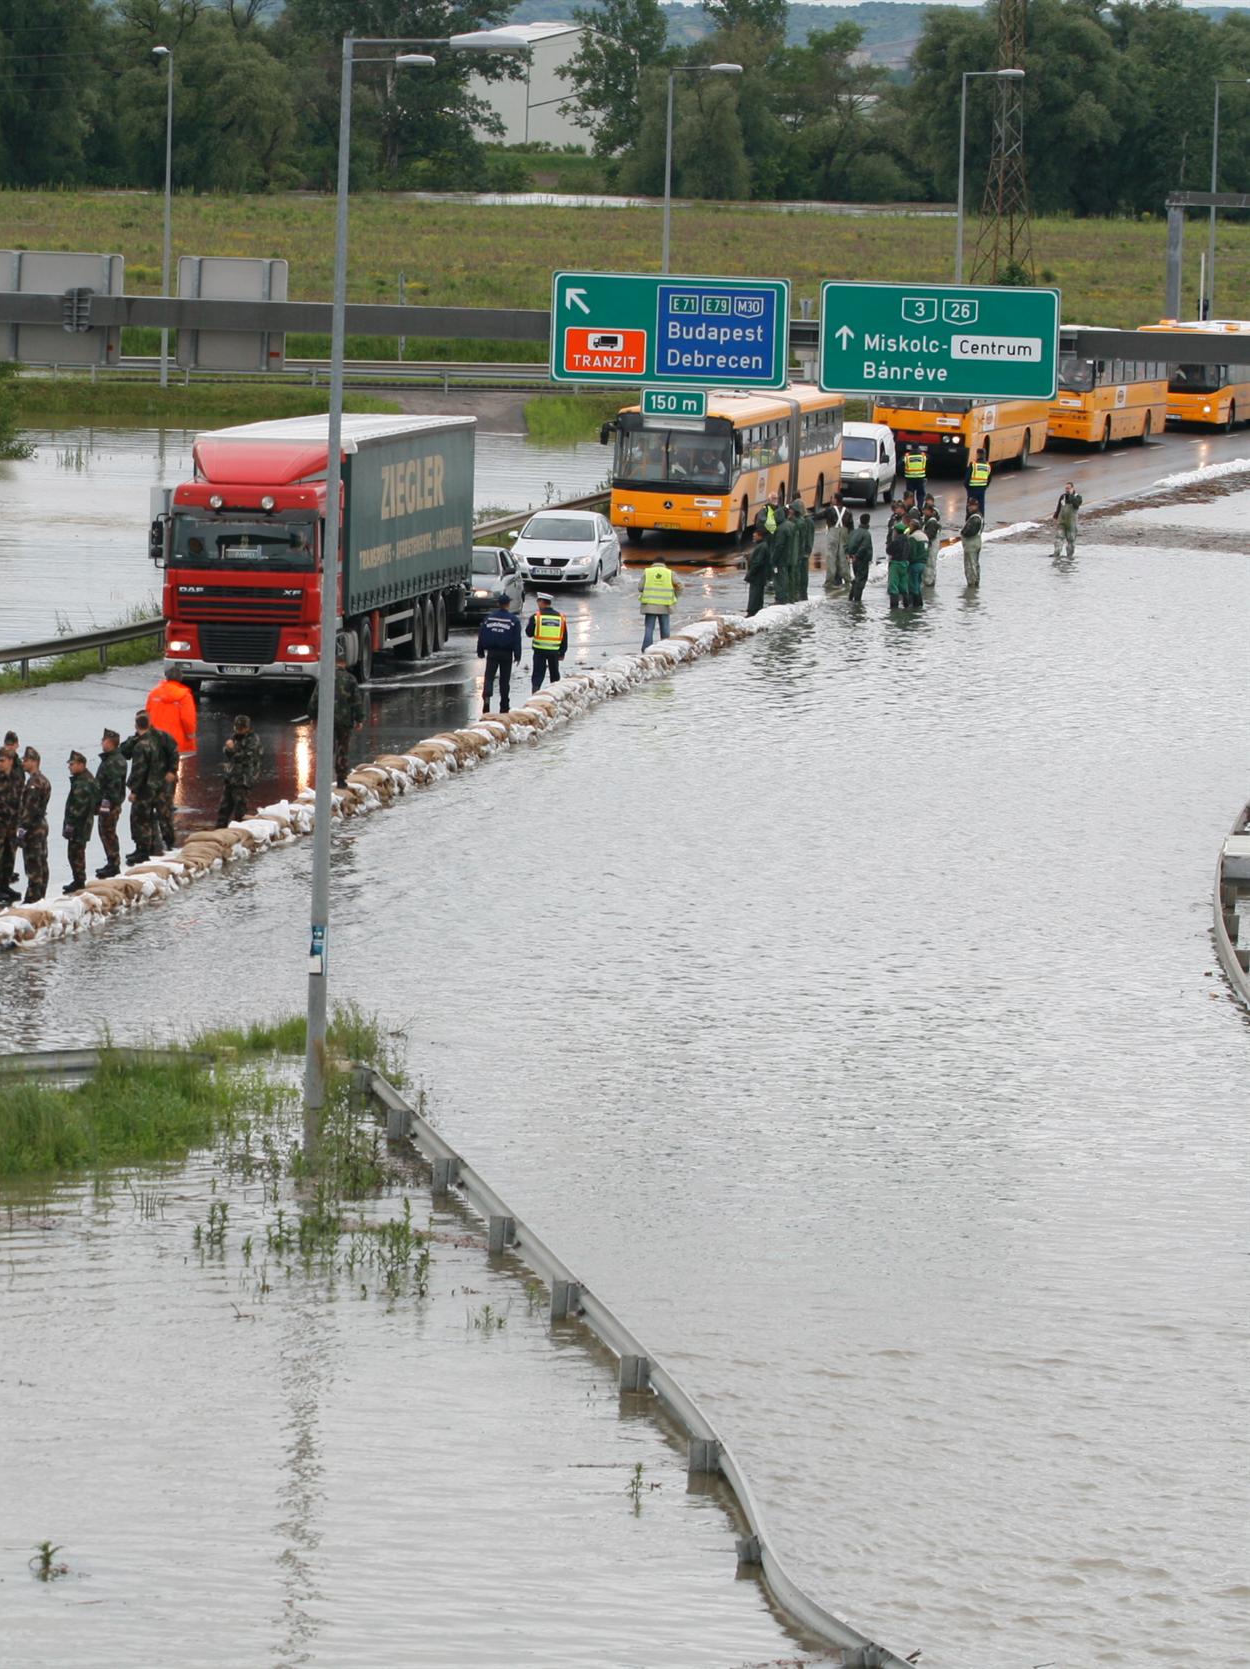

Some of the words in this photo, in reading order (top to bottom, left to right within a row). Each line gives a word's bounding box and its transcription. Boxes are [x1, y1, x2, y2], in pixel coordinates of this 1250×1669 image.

[673, 298, 680, 310] E
[682, 299, 695, 311] 71
[705, 300, 712, 312] E
[714, 301, 728, 313] 79
[737, 301, 760, 313] M30
[914, 302, 926, 317] 3
[950, 303, 971, 319] 26
[668, 321, 764, 345] Budapest
[864, 333, 949, 353] Miskolc-
[959, 340, 1032, 357] Centrum
[573, 354, 637, 369] TRANZIT
[667, 349, 763, 369] Debrecen
[863, 360, 948, 381] Bánréve
[650, 395, 678, 411] 150
[682, 399, 697, 411] m
[381, 454, 445, 521] ZIEGLER
